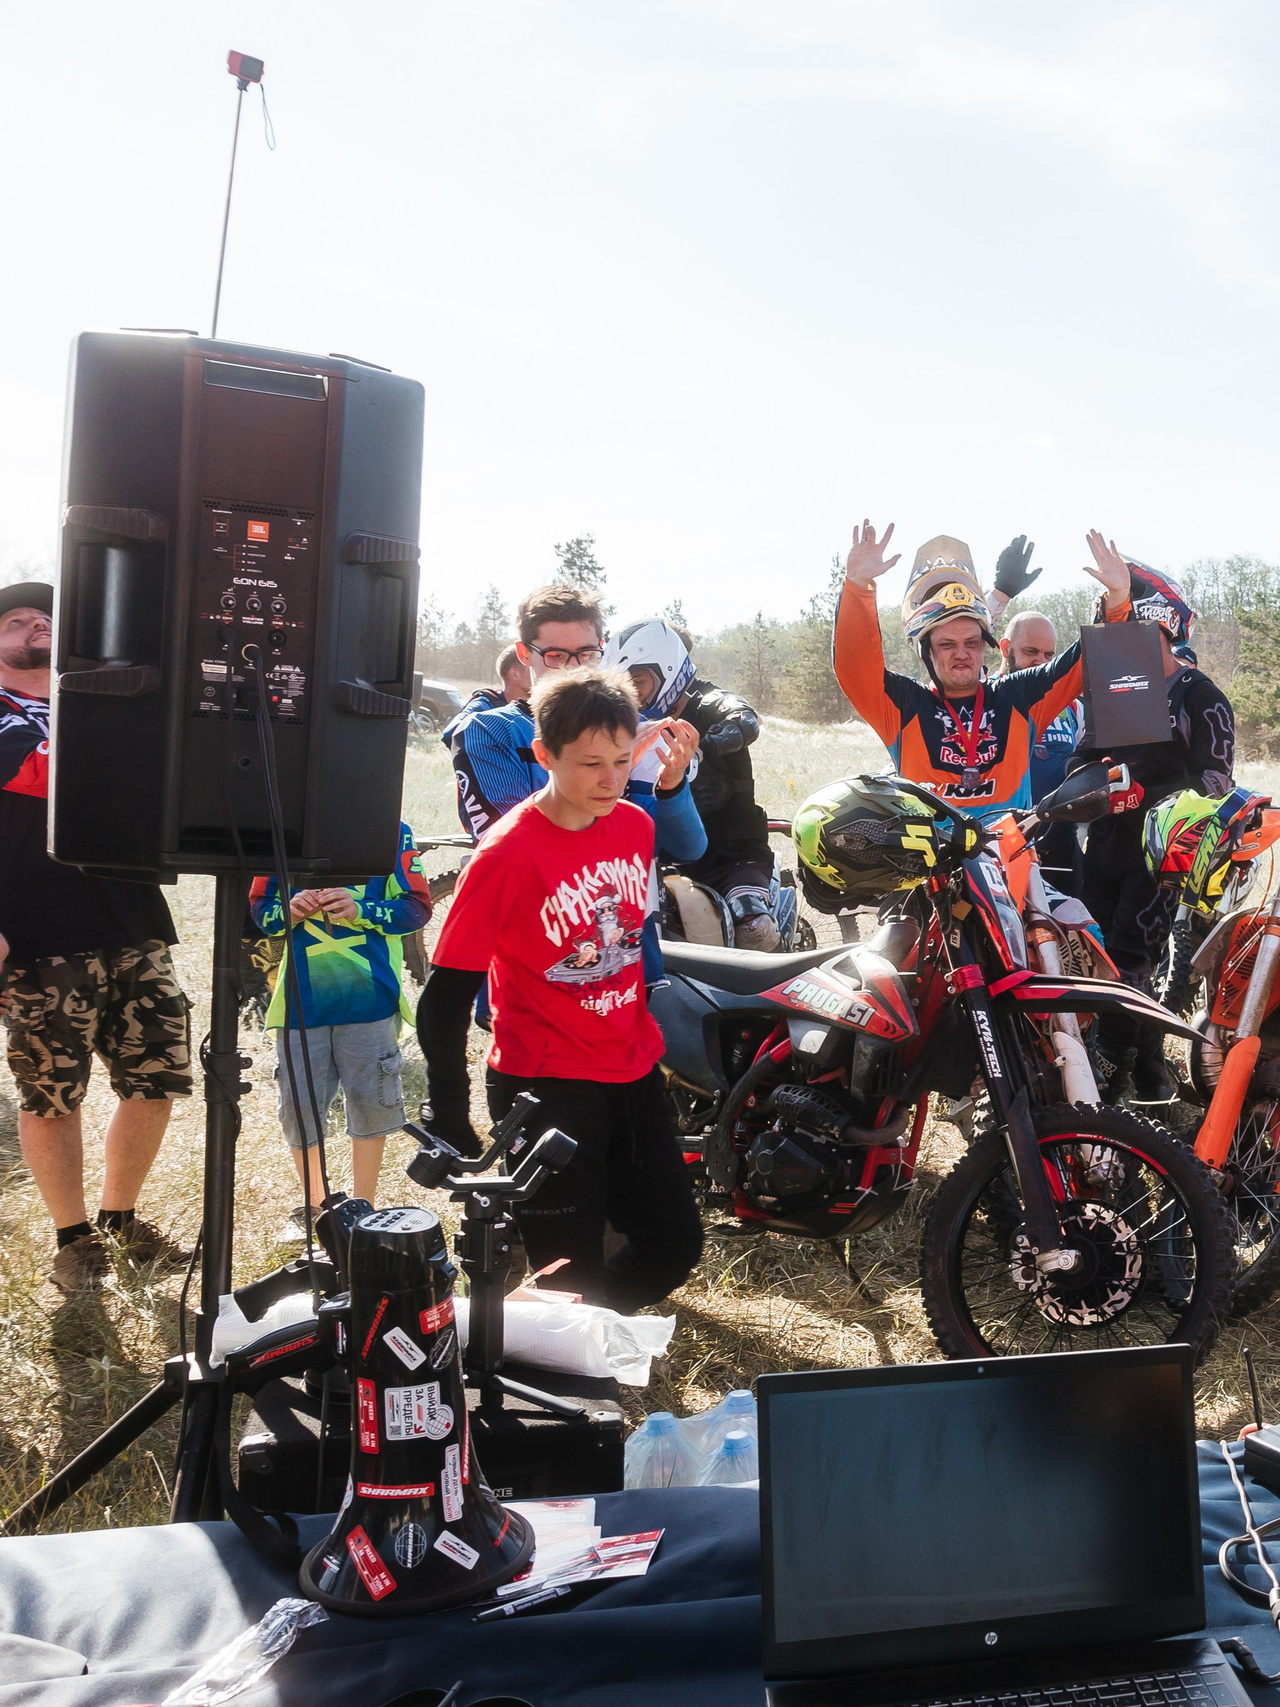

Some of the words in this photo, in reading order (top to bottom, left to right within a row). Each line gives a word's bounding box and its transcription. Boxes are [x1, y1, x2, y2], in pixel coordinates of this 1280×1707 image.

[252, 524, 266, 534] JBL
[233, 577, 257, 586] EON
[258, 579, 278, 588] 615
[656, 658, 695, 714] 100%
[782, 978, 876, 1028] PROGASI
[976, 1010, 1002, 1078] KYB-TECH
[403, 1390, 413, 1436] ПРЕДЕЛЫ
[415, 1388, 424, 1401] ЗА
[427, 1385, 437, 1421] ВЫЙДИ
[359, 1485, 430, 1496] SHARMAX
[406, 1522, 414, 1569] SHARMAX
